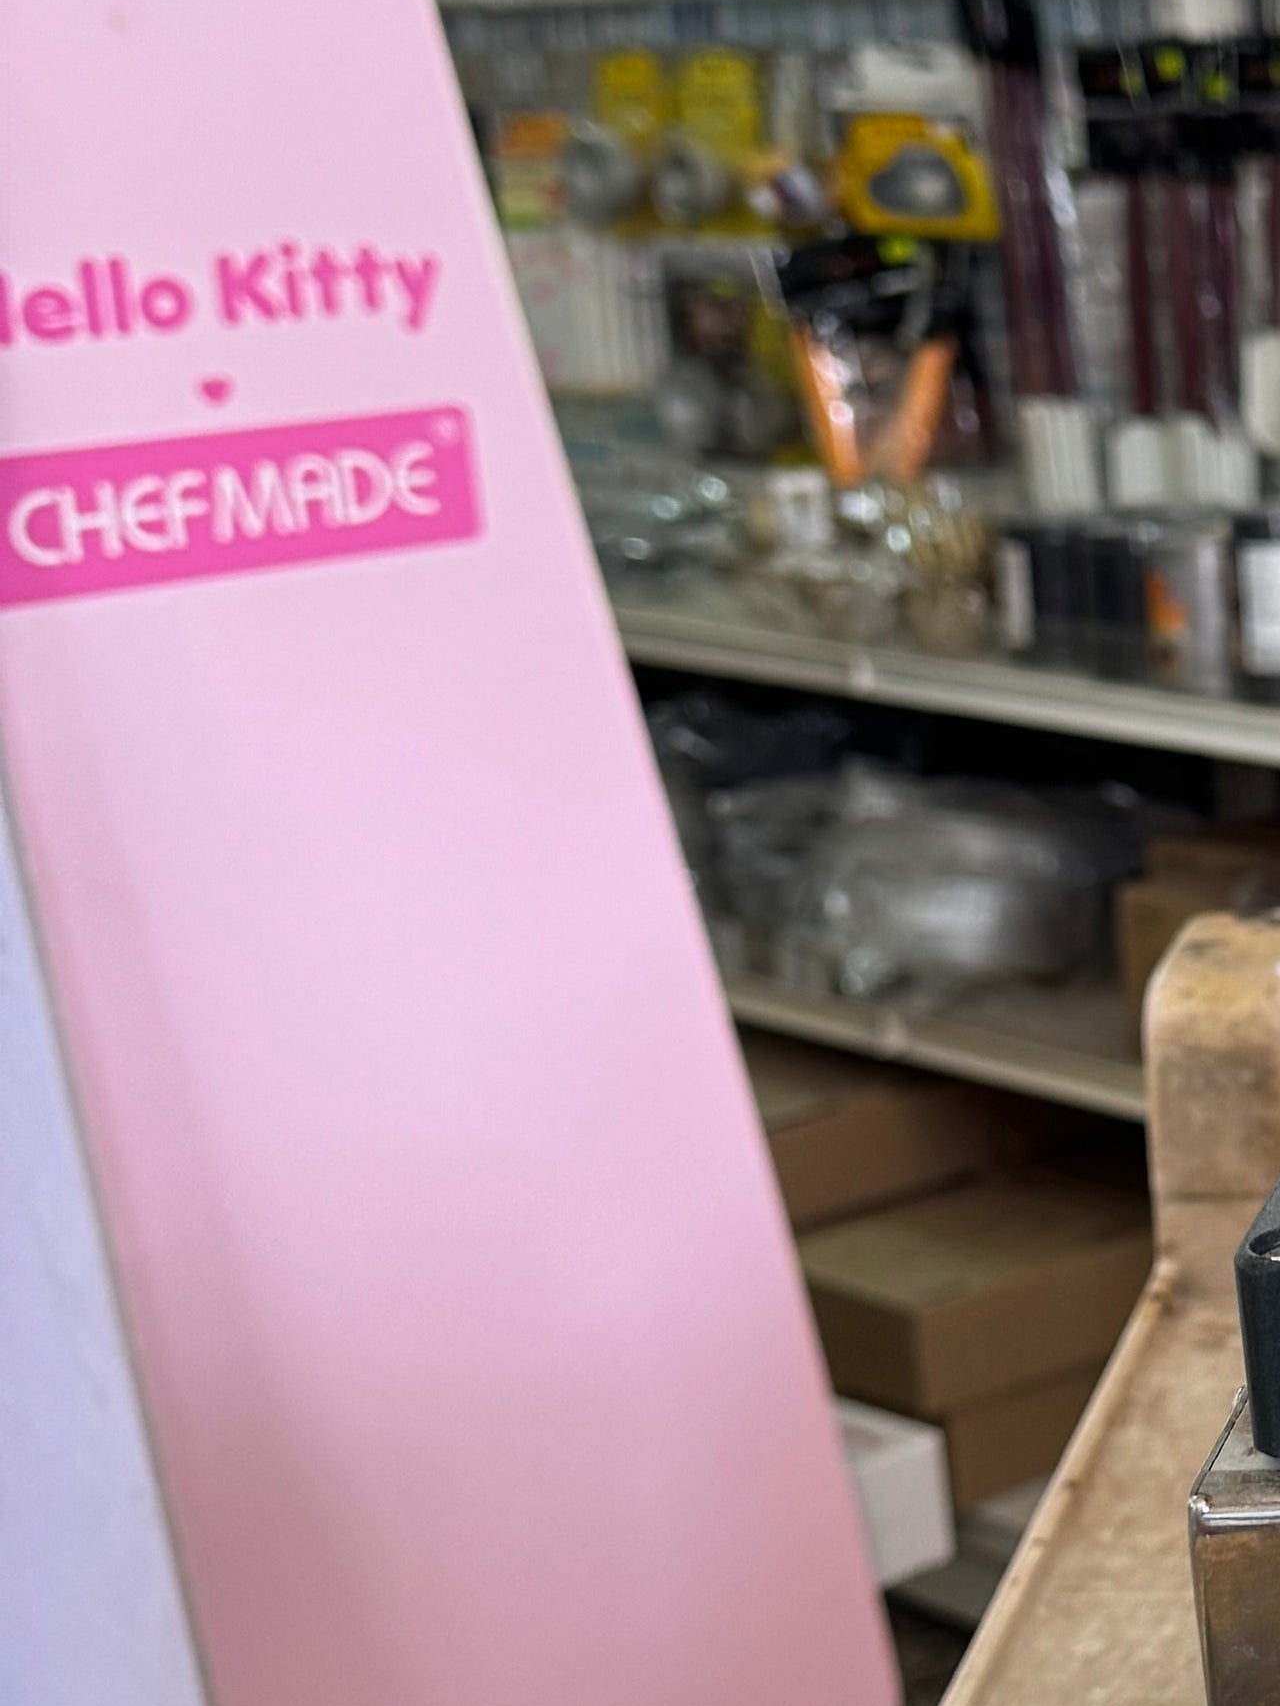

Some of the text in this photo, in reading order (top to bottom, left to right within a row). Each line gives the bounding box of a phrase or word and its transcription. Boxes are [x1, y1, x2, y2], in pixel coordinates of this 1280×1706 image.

[0, 242, 438, 348] ello Kitty
[7, 441, 442, 567] CHEFMADE
